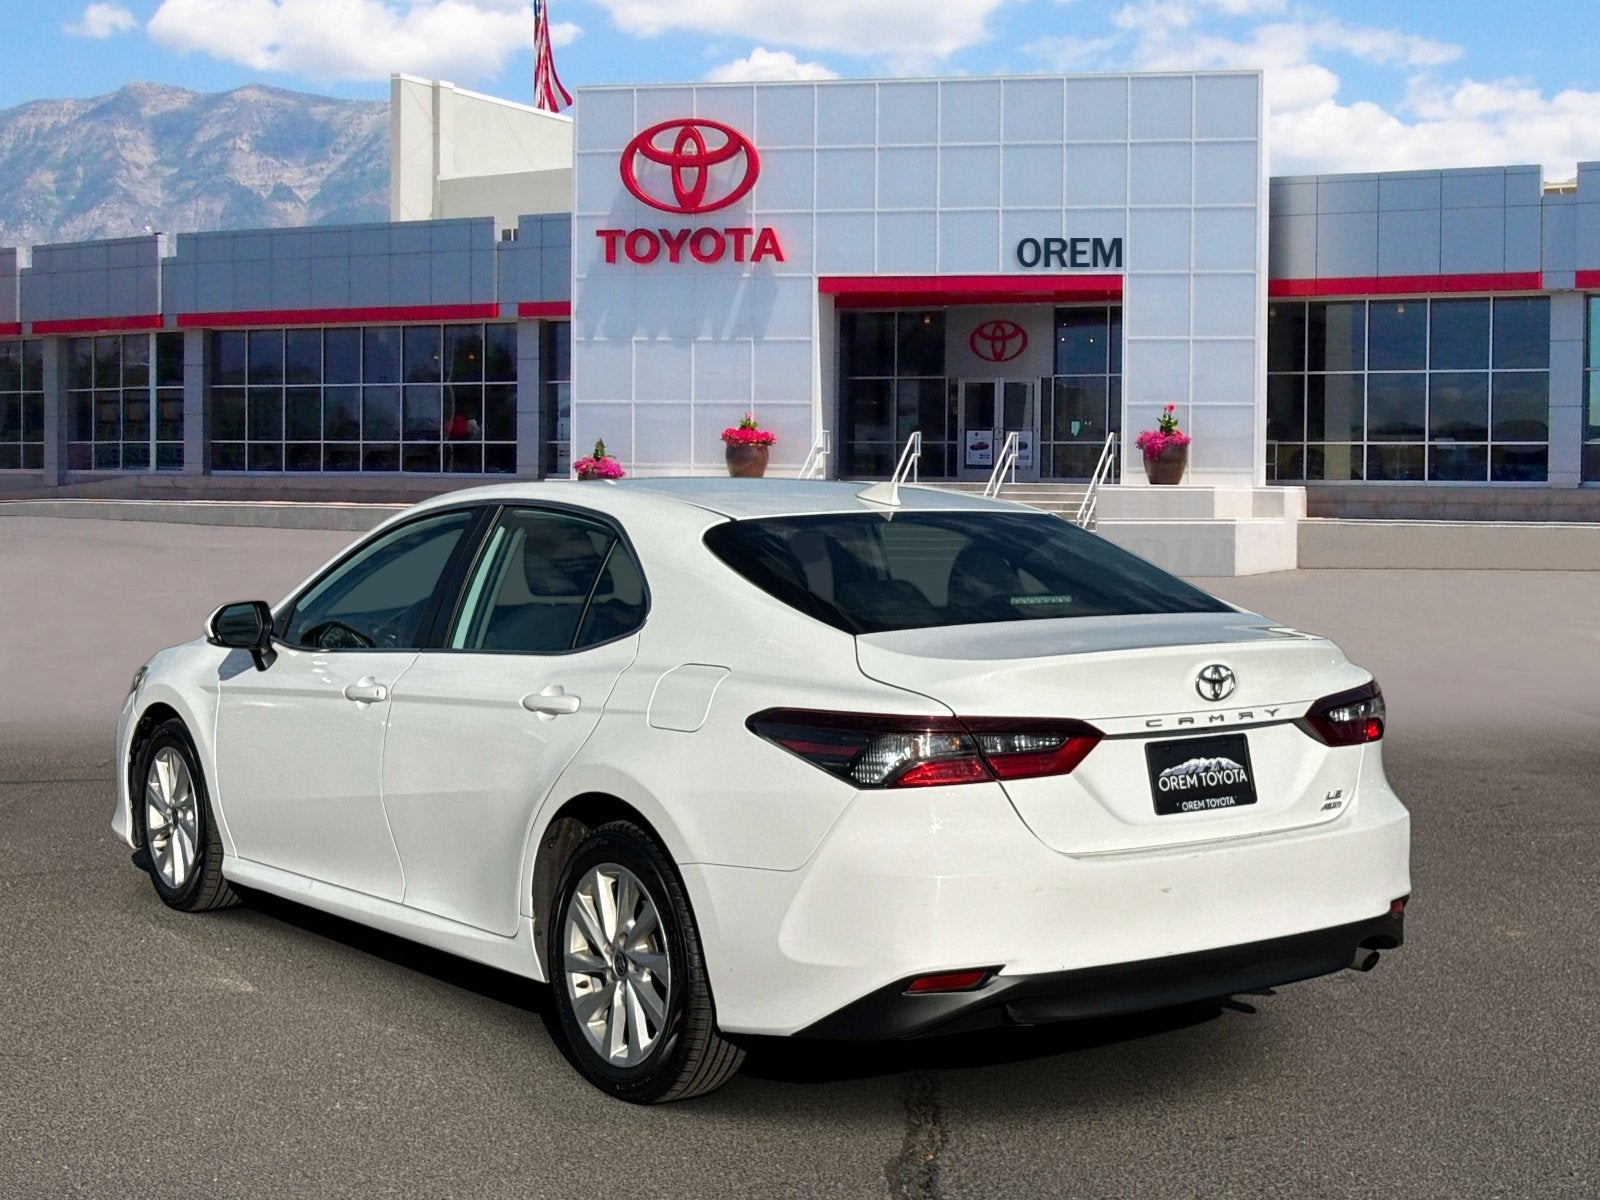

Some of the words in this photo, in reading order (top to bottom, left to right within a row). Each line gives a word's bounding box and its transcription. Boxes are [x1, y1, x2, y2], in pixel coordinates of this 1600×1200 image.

[596, 227, 785, 264] TOYOTA
[1016, 237, 1123, 268] OREM
[1145, 708, 1280, 728] CAMRY
[1159, 774, 1198, 792] OREM
[1200, 768, 1248, 787] TOYOTA
[1181, 799, 1205, 811] OREM
[1205, 796, 1236, 809] TOYOTA
[1325, 790, 1343, 801] LE
